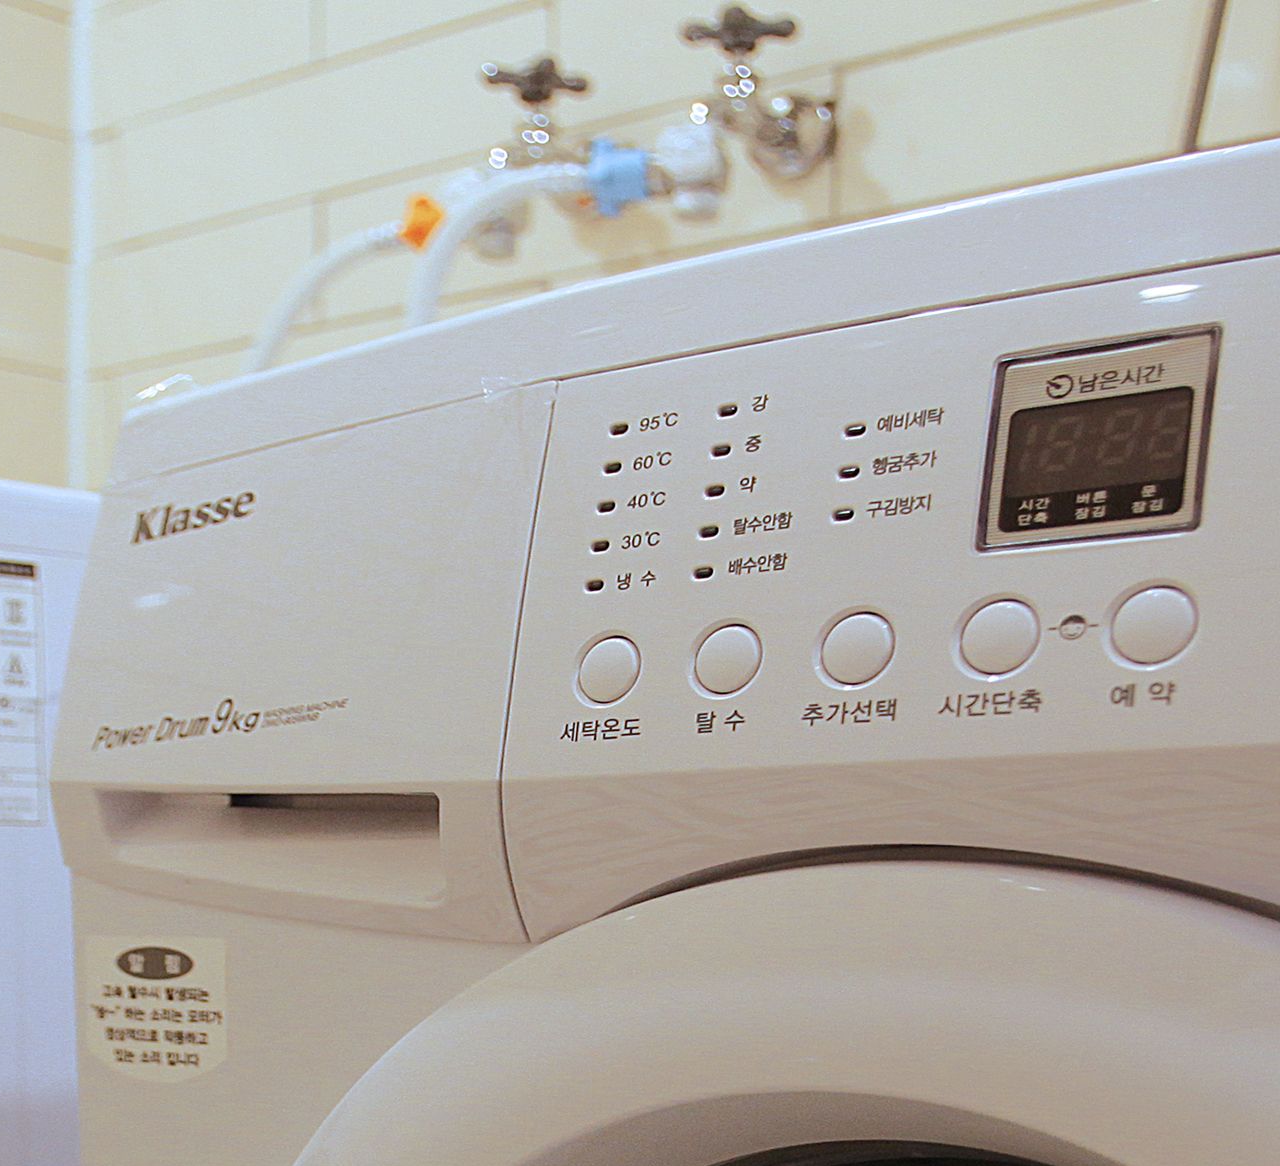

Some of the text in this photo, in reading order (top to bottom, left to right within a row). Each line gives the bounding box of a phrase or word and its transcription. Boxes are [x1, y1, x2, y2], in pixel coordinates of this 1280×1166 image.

[1078, 363, 1165, 393] 남은시간
[750, 393, 769, 413] 강
[876, 406, 945, 433] 예비세탁
[744, 434, 762, 453] 중
[871, 450, 937, 475] 헹굼추가
[739, 475, 758, 494] 약
[1075, 490, 1107, 504] 버튼
[865, 493, 932, 518] 구김방지
[1019, 497, 1051, 511] 시간
[130, 490, 257, 545] Klasse
[732, 511, 793, 536] 탈수안함
[1017, 511, 1049, 526] 단축
[727, 552, 788, 577] 배수안함
[801, 698, 898, 726] 추가선택
[937, 687, 1043, 719] 시간단축
[92, 724, 152, 750] Power
[155, 716, 210, 742] Drum
[211, 698, 261, 733] 9kg
[560, 716, 642, 743] 세탁온도
